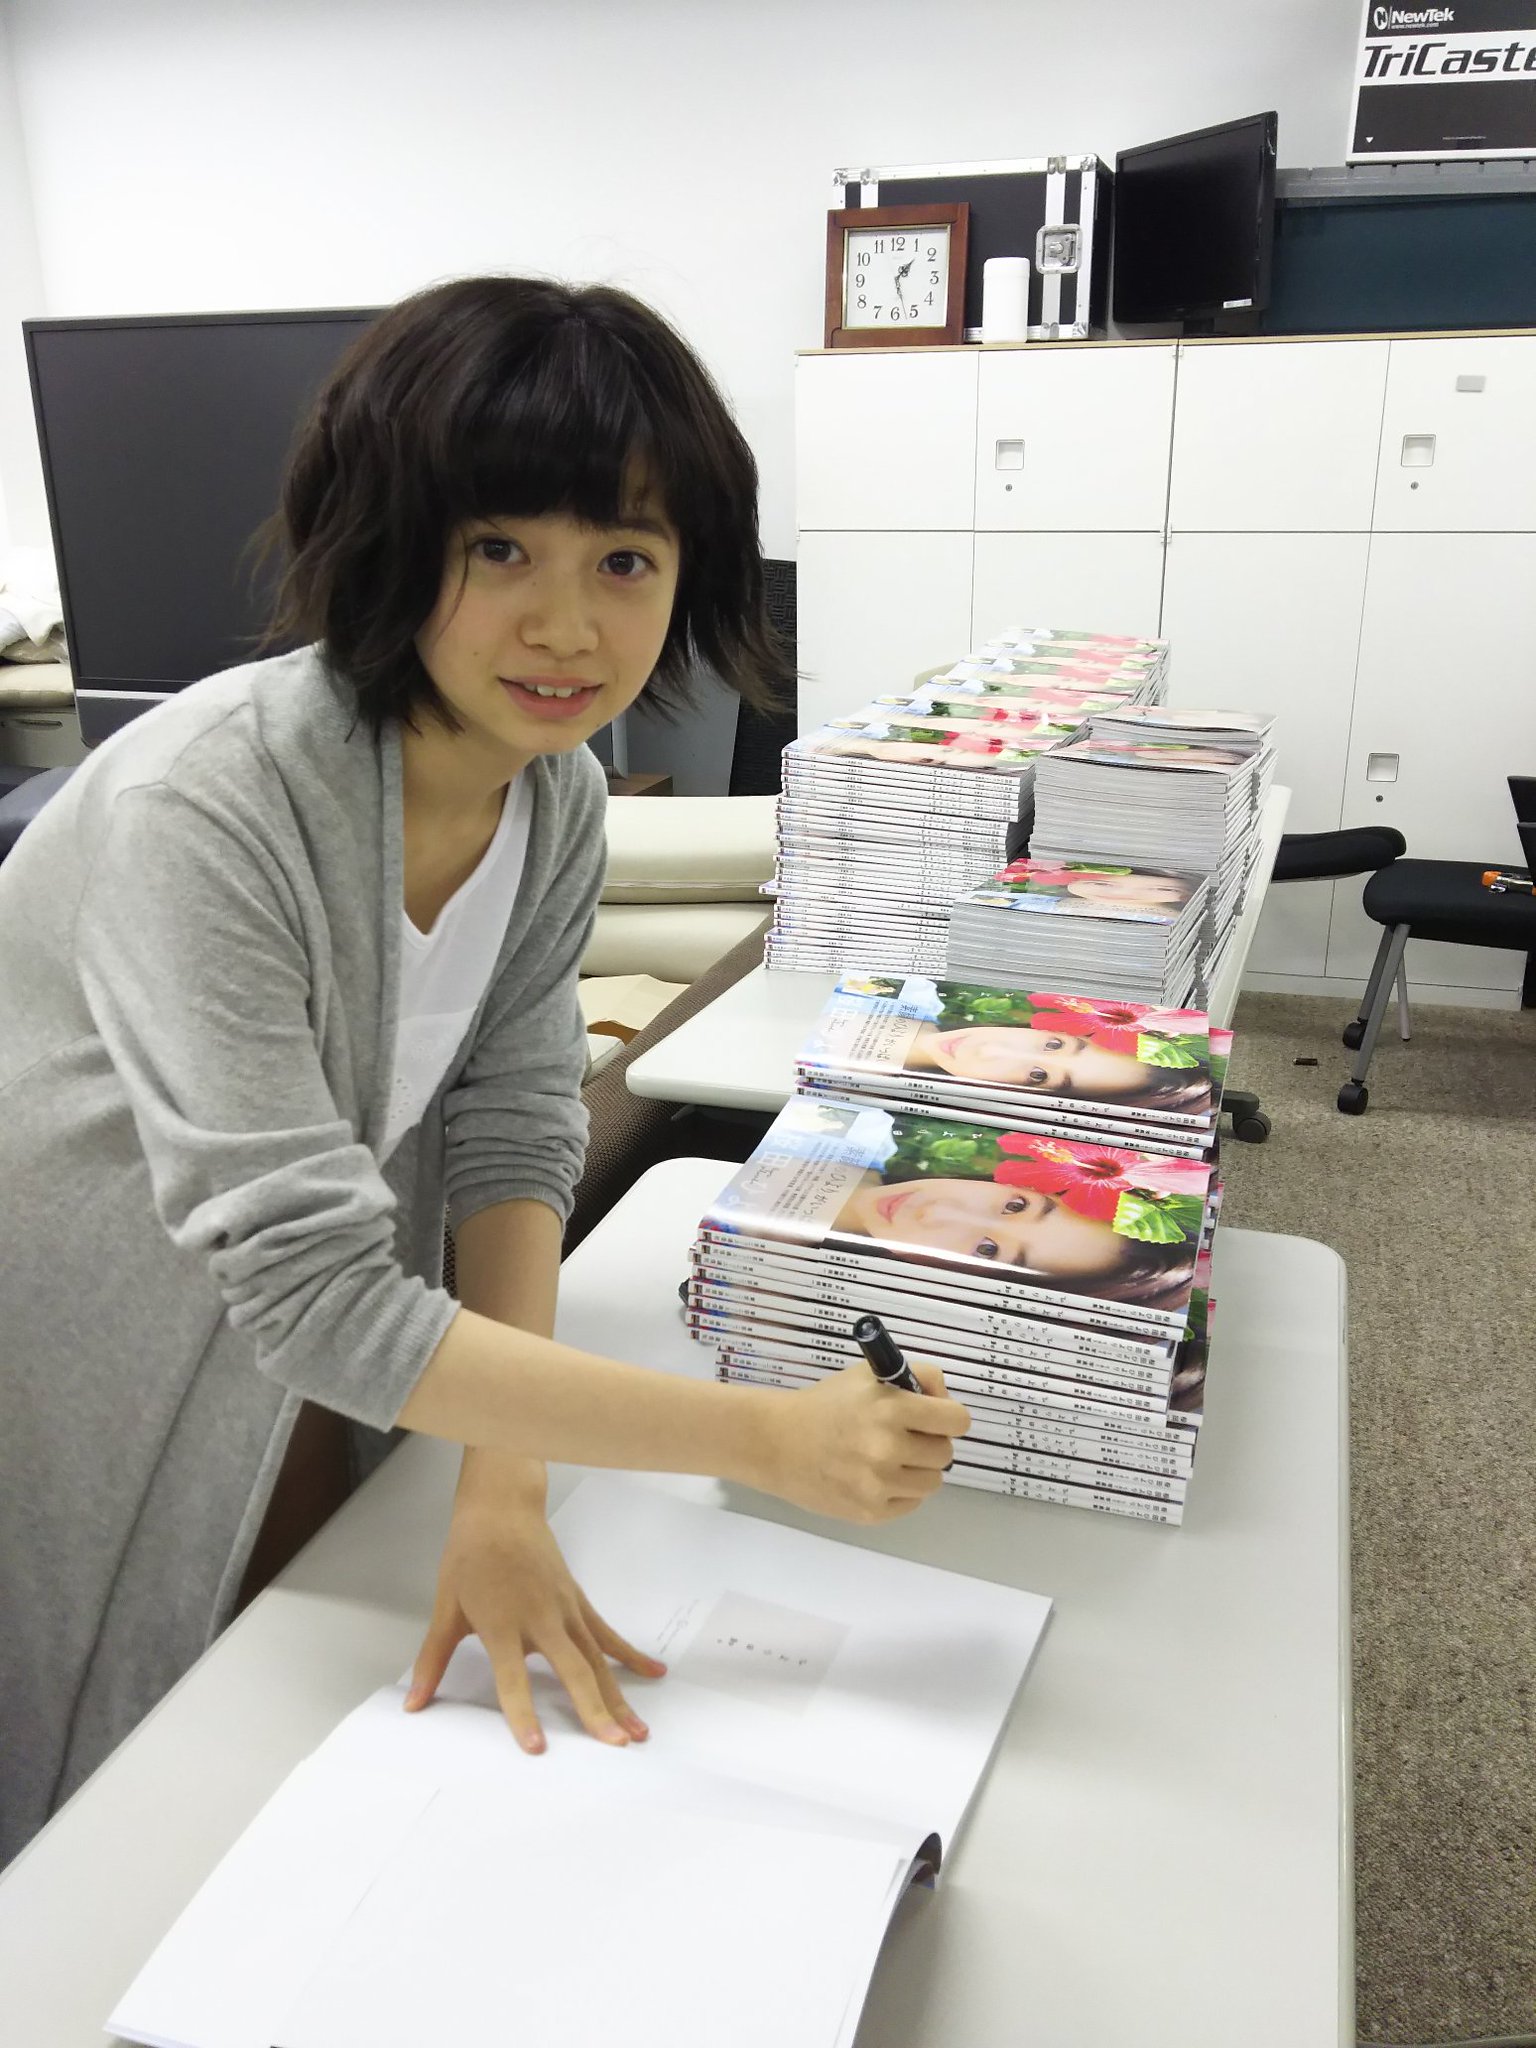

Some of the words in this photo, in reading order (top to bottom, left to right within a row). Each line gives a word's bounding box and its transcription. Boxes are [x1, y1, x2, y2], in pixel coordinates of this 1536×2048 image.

[1391, 8, 1454, 24] NewTek
[874, 240, 885, 253] 11
[890, 237, 905, 251] 12
[914, 238, 919, 252] 1
[857, 252, 870, 267] 10
[927, 248, 937, 262] 2
[855, 274, 865, 288] 9
[930, 271, 939, 284] 3
[857, 295, 867, 309] 8
[924, 291, 934, 305] 4
[873, 306, 882, 320] 7
[890, 307, 900, 320] 6
[909, 304, 918, 318] 5
